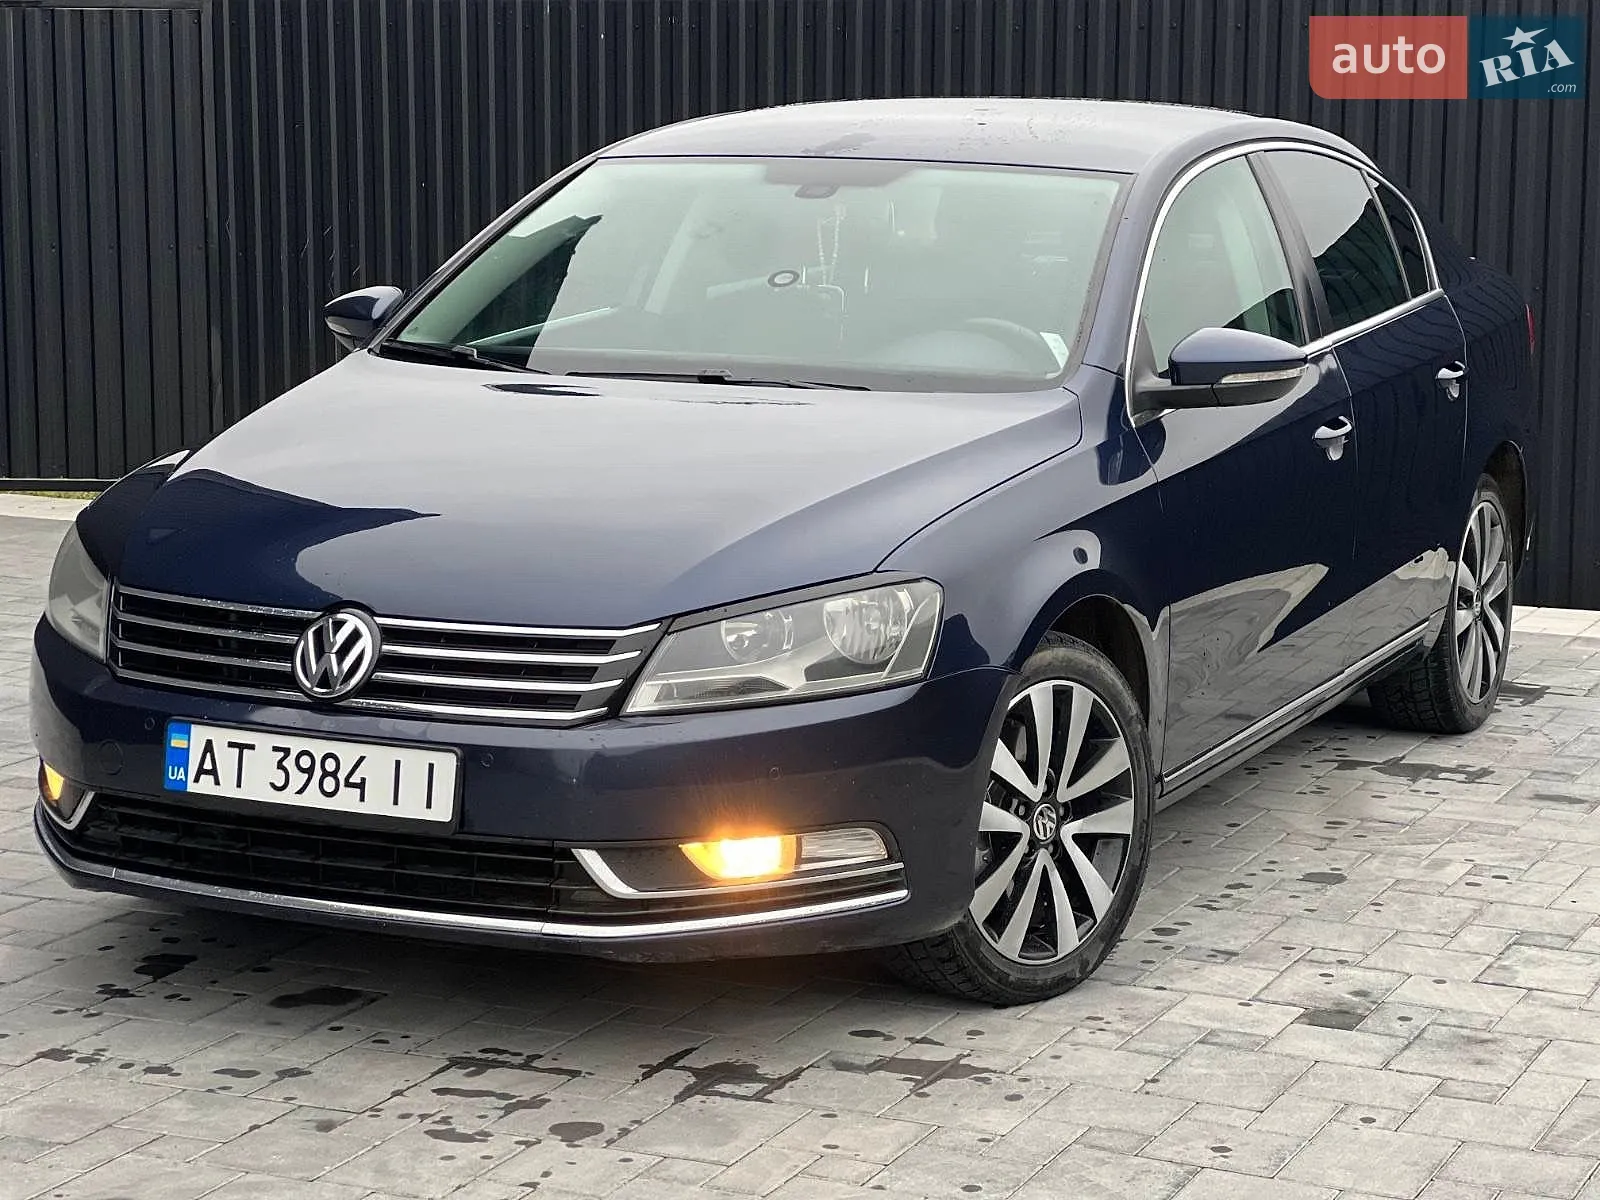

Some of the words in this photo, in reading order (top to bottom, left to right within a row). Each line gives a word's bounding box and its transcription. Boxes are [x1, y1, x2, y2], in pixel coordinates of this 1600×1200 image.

[168, 765, 186, 781] UA
[193, 738, 256, 788] AT
[269, 745, 367, 803] 3984
